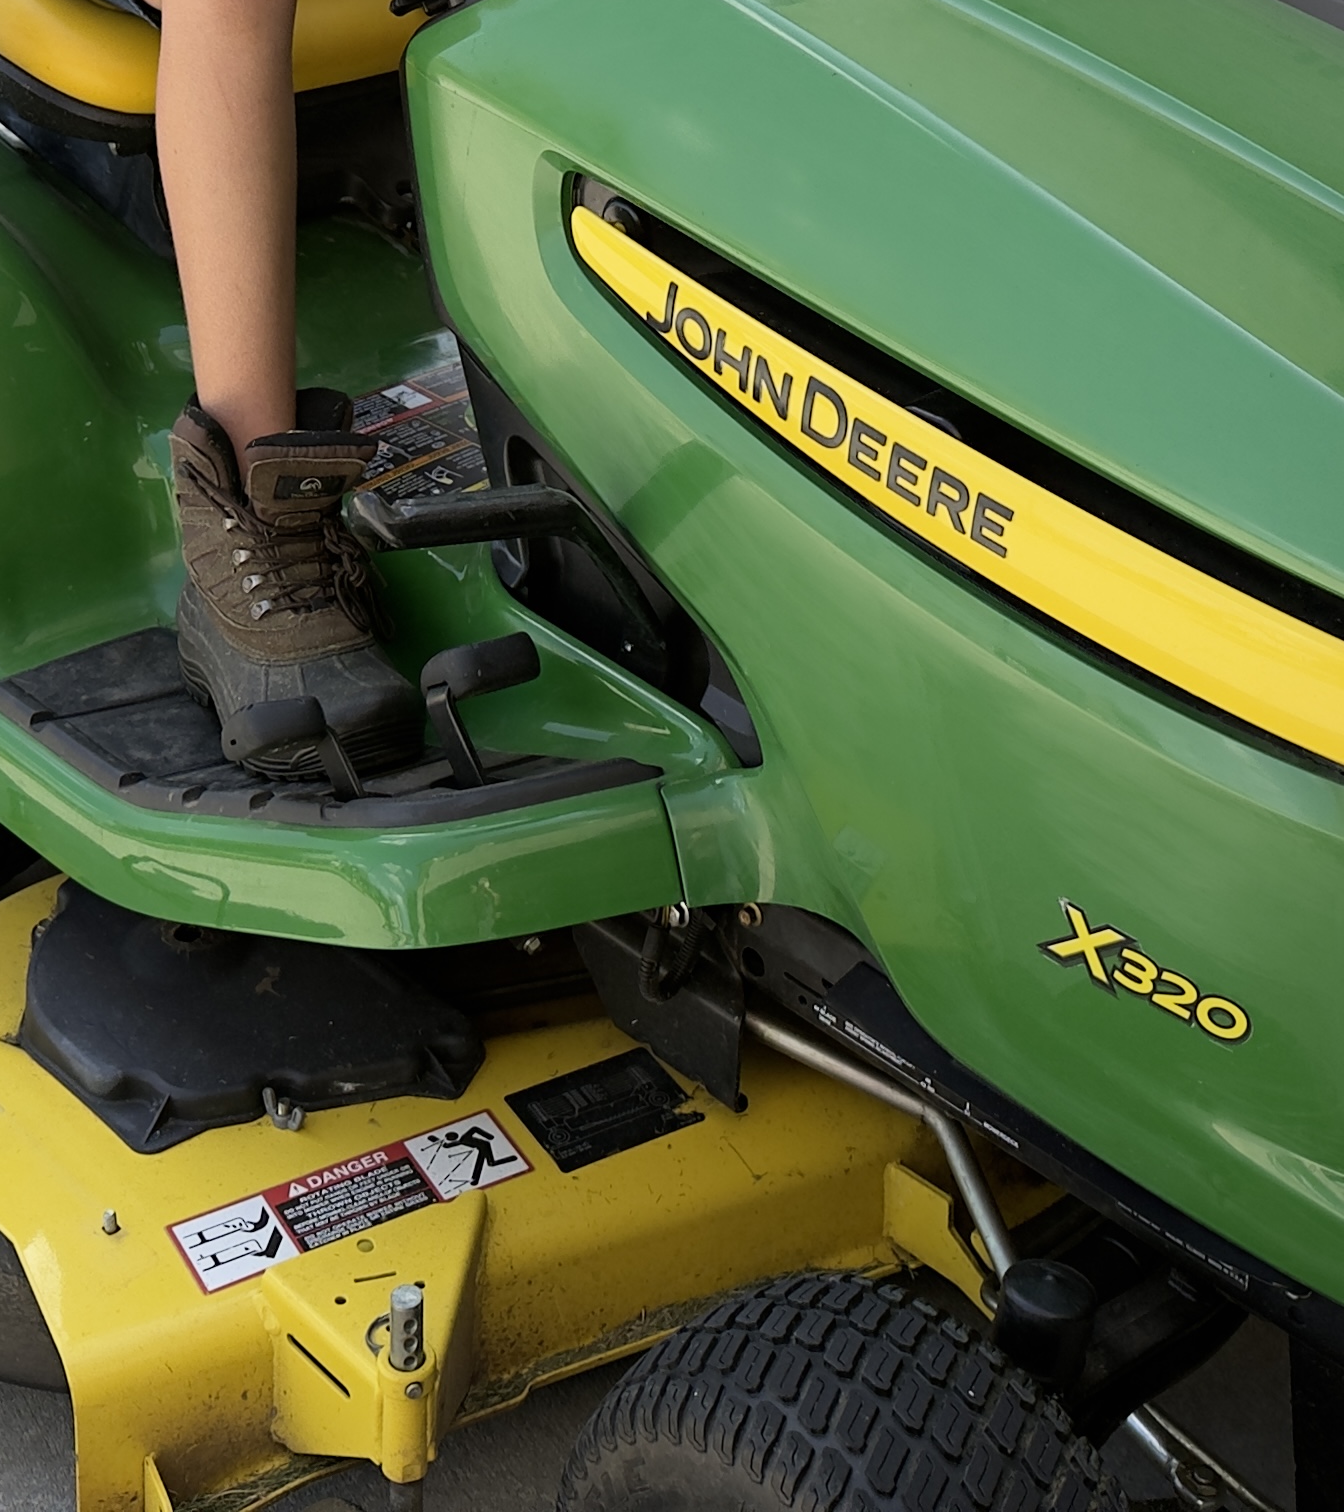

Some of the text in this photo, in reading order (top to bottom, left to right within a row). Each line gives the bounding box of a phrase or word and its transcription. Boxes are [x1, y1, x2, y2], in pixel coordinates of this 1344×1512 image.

[644, 281, 1016, 559] JOHN DEERE
[1039, 901, 1251, 1042] X320
[306, 1151, 389, 1189] DANGER
